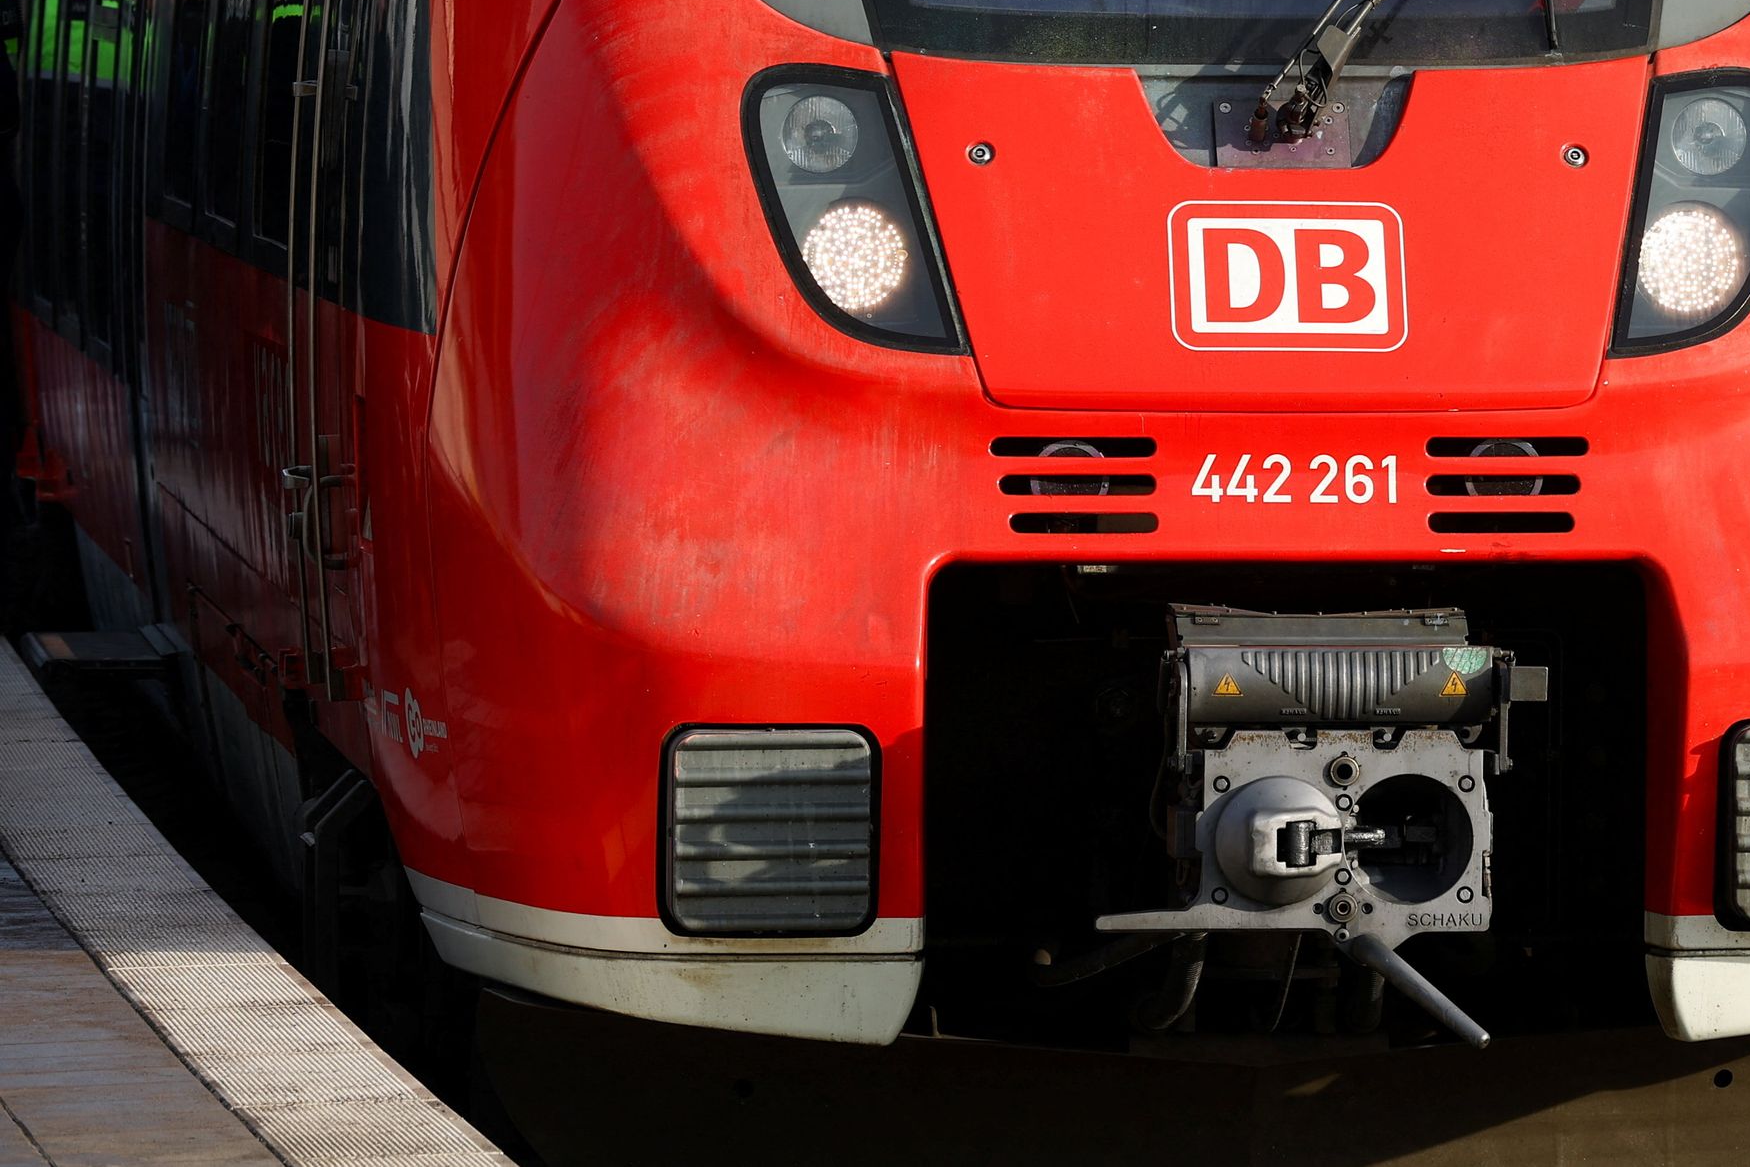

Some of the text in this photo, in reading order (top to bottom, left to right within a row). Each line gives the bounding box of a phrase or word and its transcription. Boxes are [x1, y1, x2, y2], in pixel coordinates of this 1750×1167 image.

[1202, 228, 1376, 324] DB
[1191, 453, 1398, 504] 442 261
[1407, 912, 1483, 928] SCHAKU
